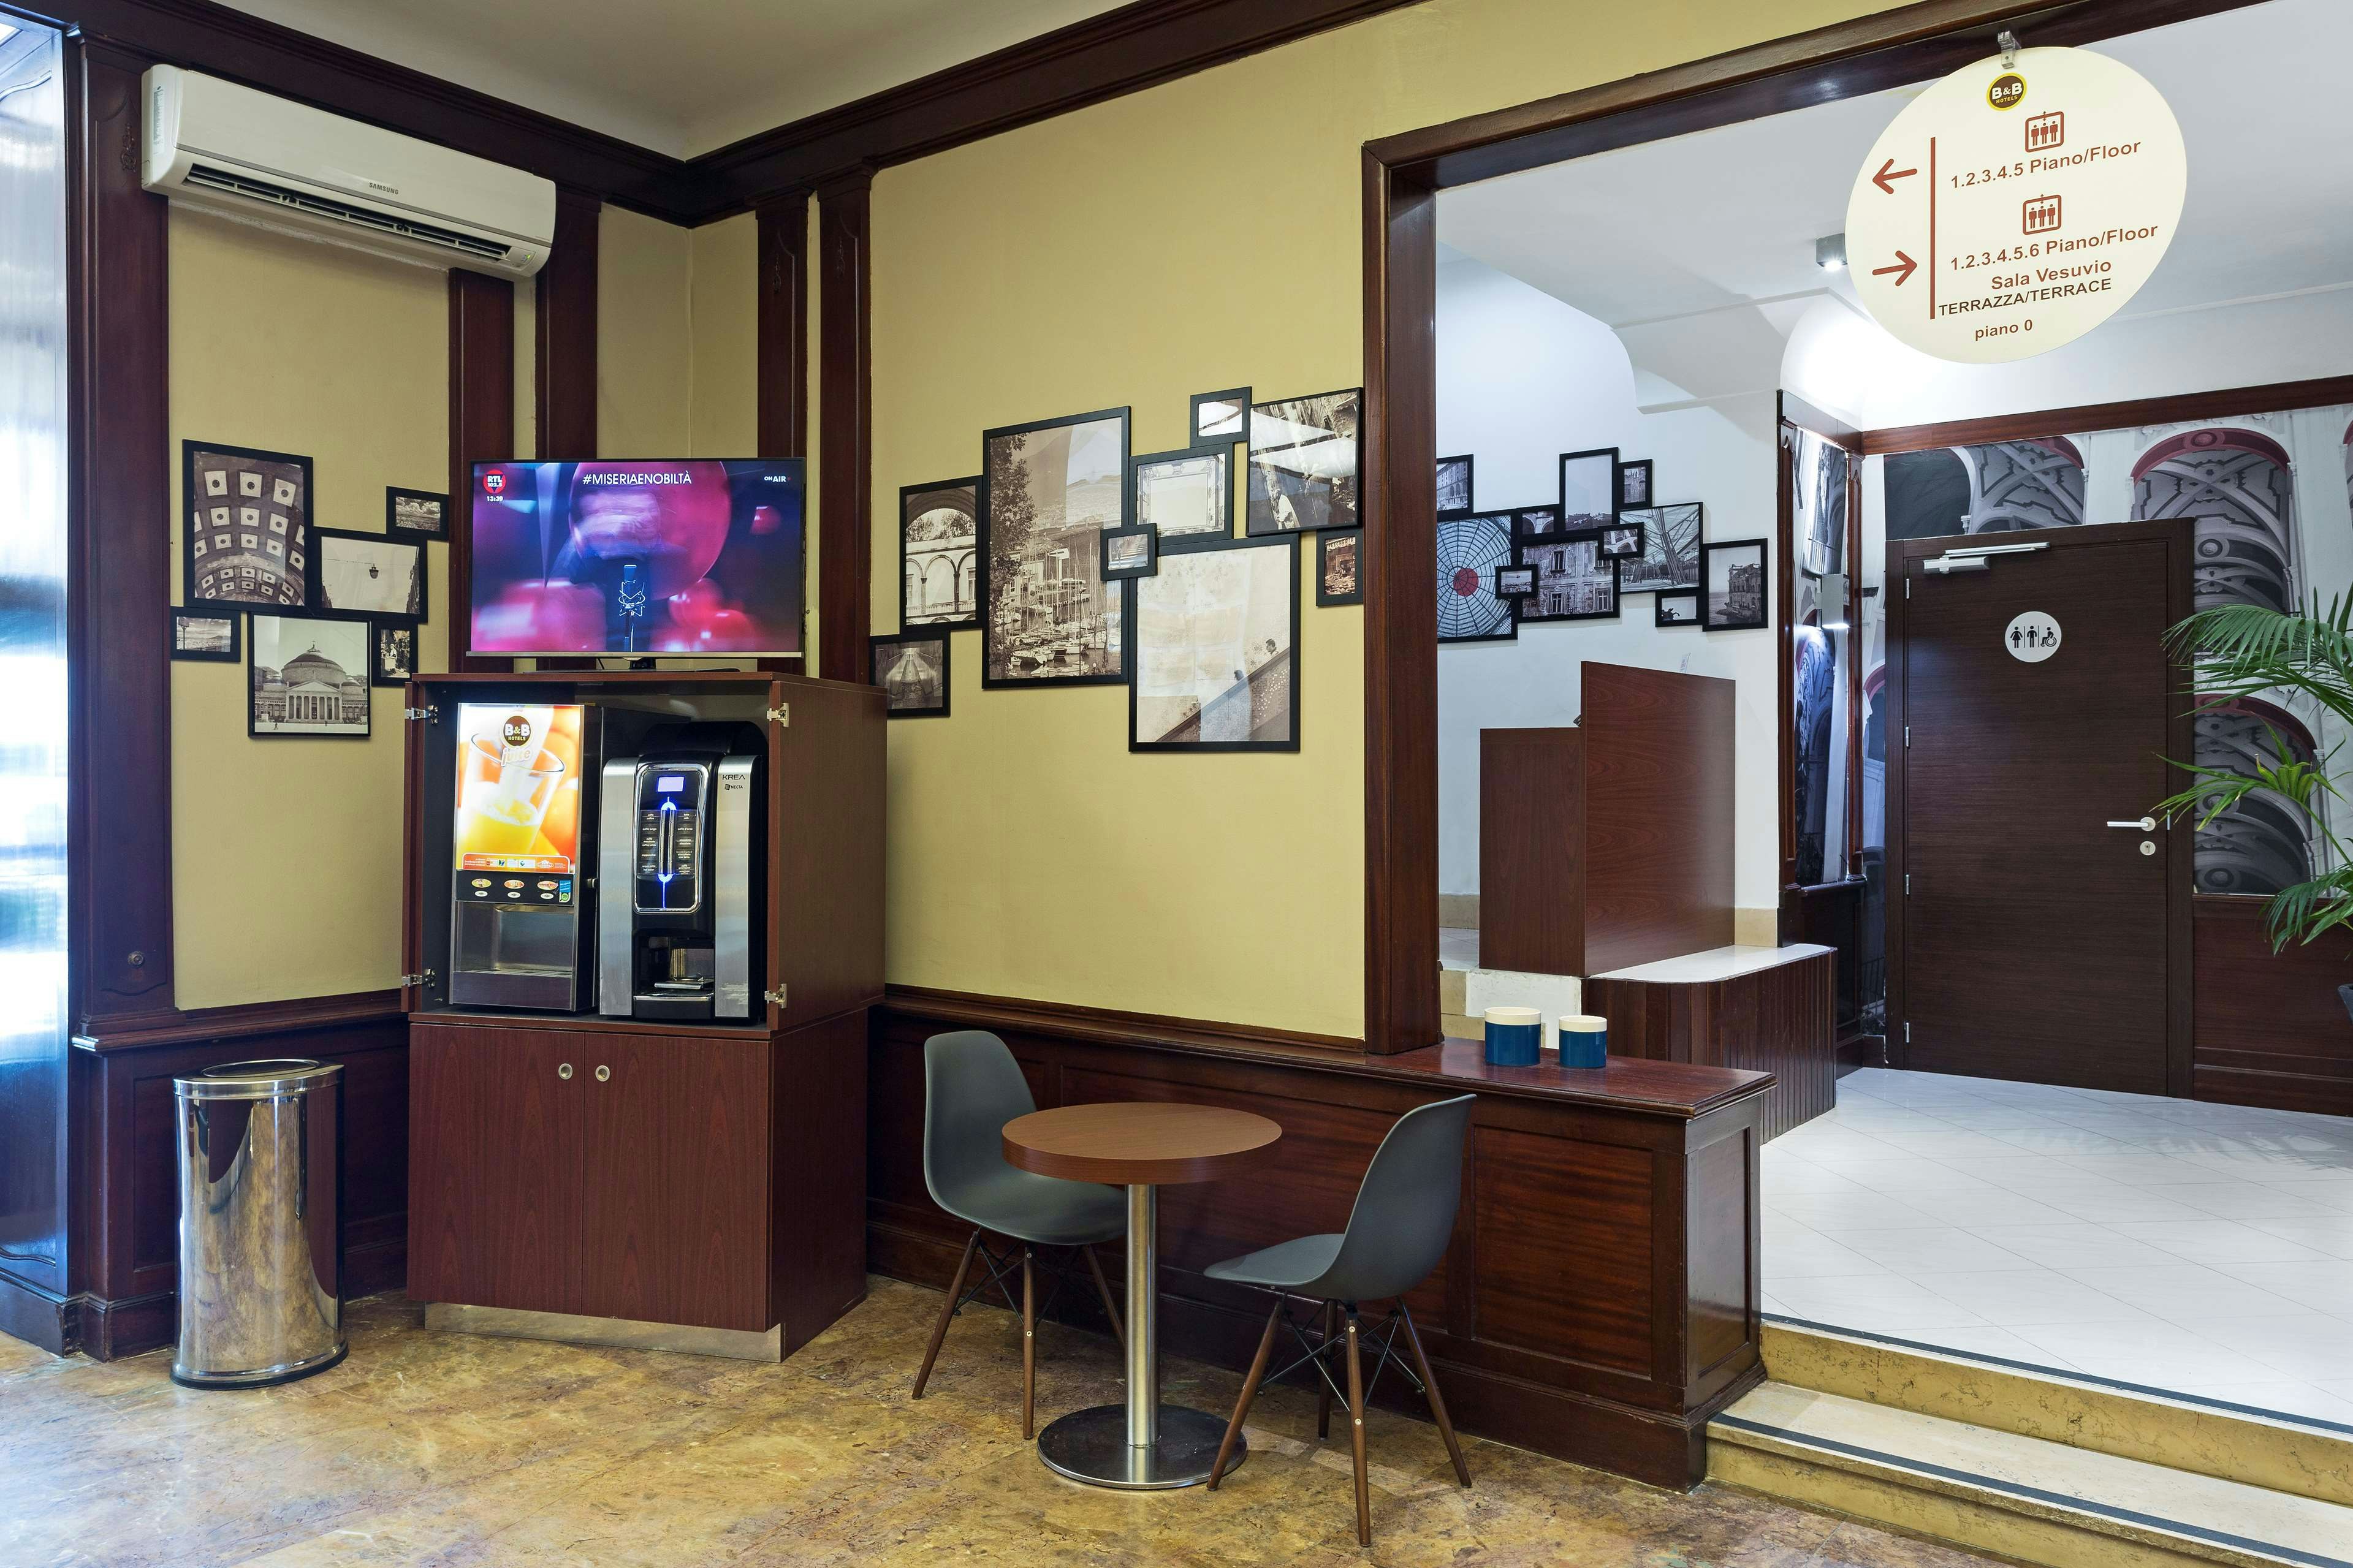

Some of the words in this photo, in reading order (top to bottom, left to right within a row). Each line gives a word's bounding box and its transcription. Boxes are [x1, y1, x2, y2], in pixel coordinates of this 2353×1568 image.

[1992, 82, 2023, 100] B&B
[1996, 95, 2018, 104] HOTELS
[1951, 162, 2023, 189] 1.2.3.4.5
[2030, 142, 2141, 173] Piano/Floor
[369, 182, 399, 195] SAMSUNG
[1951, 243, 2039, 270] 1.2.3.4.5.6
[2046, 225, 2158, 255] Piano/Floor
[1991, 273, 2030, 290] Sala
[2036, 260, 2112, 282] Vesuvio
[1938, 278, 2112, 316] TERRAZZA/TERRACE
[1975, 325, 2019, 342] piano
[2024, 319, 2033, 331] 0
[583, 471, 692, 485] #MISERIAENOBILTÀ
[504, 724, 531, 737] B&B
